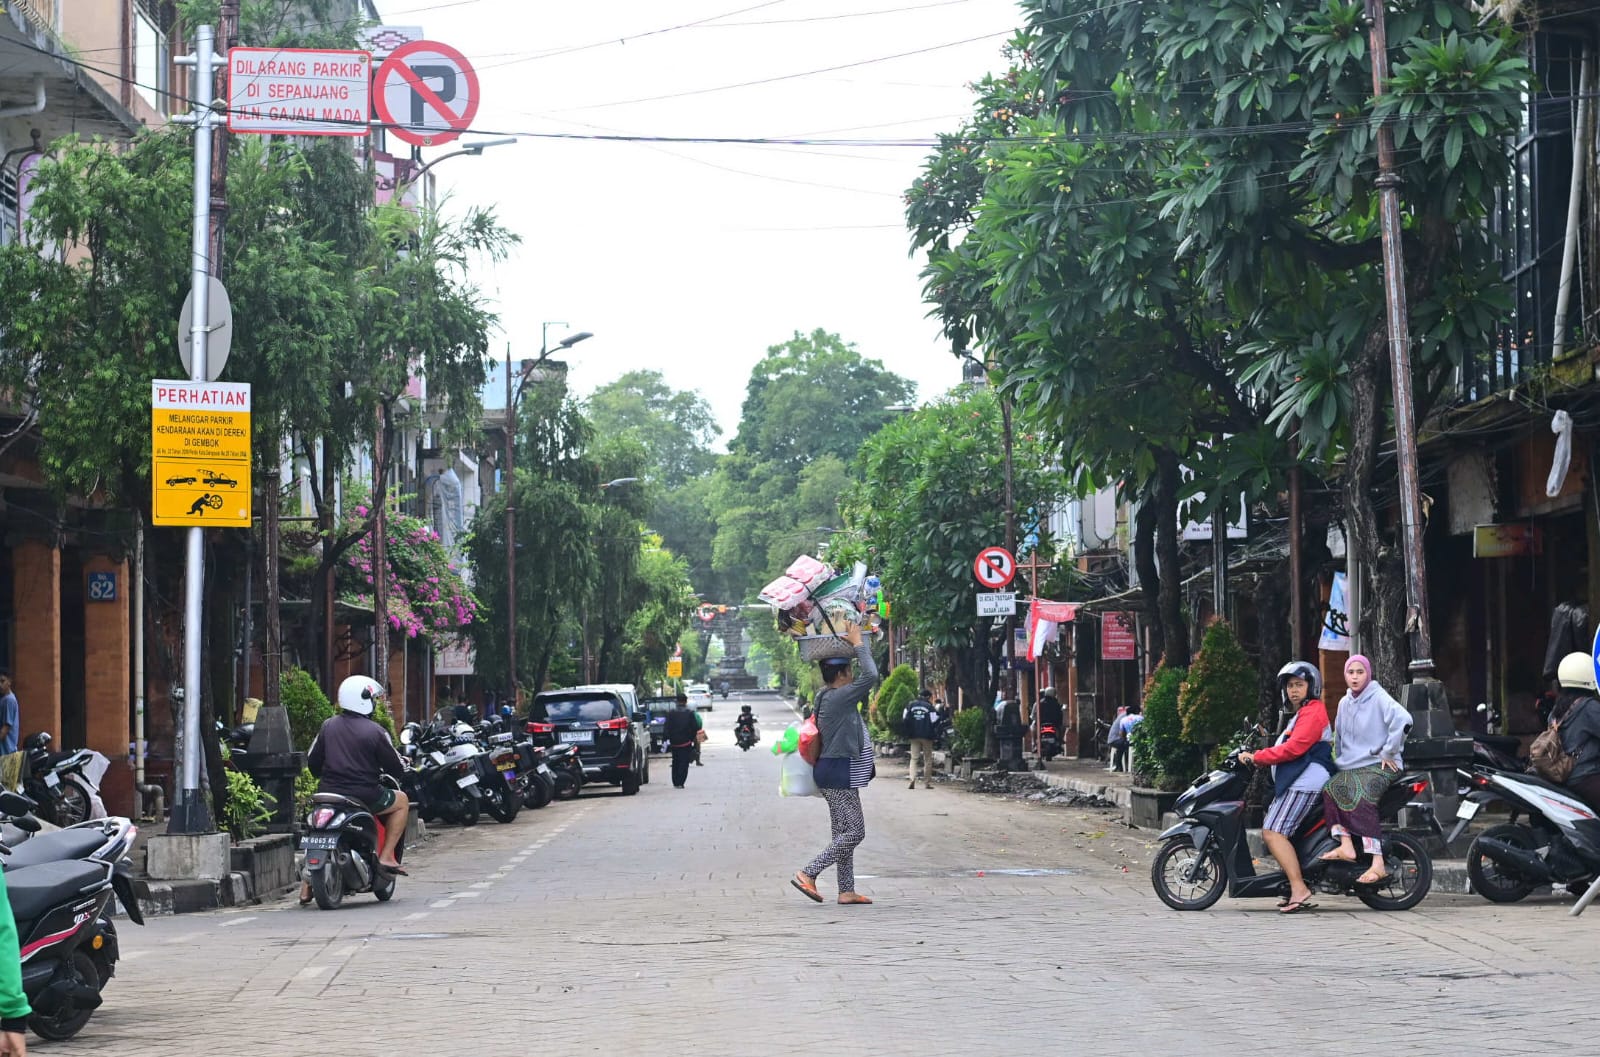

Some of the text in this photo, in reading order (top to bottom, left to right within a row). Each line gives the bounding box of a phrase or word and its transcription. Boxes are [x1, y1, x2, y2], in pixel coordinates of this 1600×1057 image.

[236, 60, 362, 78] DILARANG PARKIR
[247, 84, 349, 100] DI SEPANJANG
[236, 106, 361, 122] JLN. GAJAH MADA
[158, 388, 245, 405] PERHATIAN
[169, 414, 233, 425] MELANGGAR PARKIR
[156, 425, 195, 435] KENDARAAN
[197, 427, 214, 436] AKAN
[216, 428, 222, 436] DI
[184, 438, 219, 448] DI GEMBOK
[91, 581, 114, 599] 82
